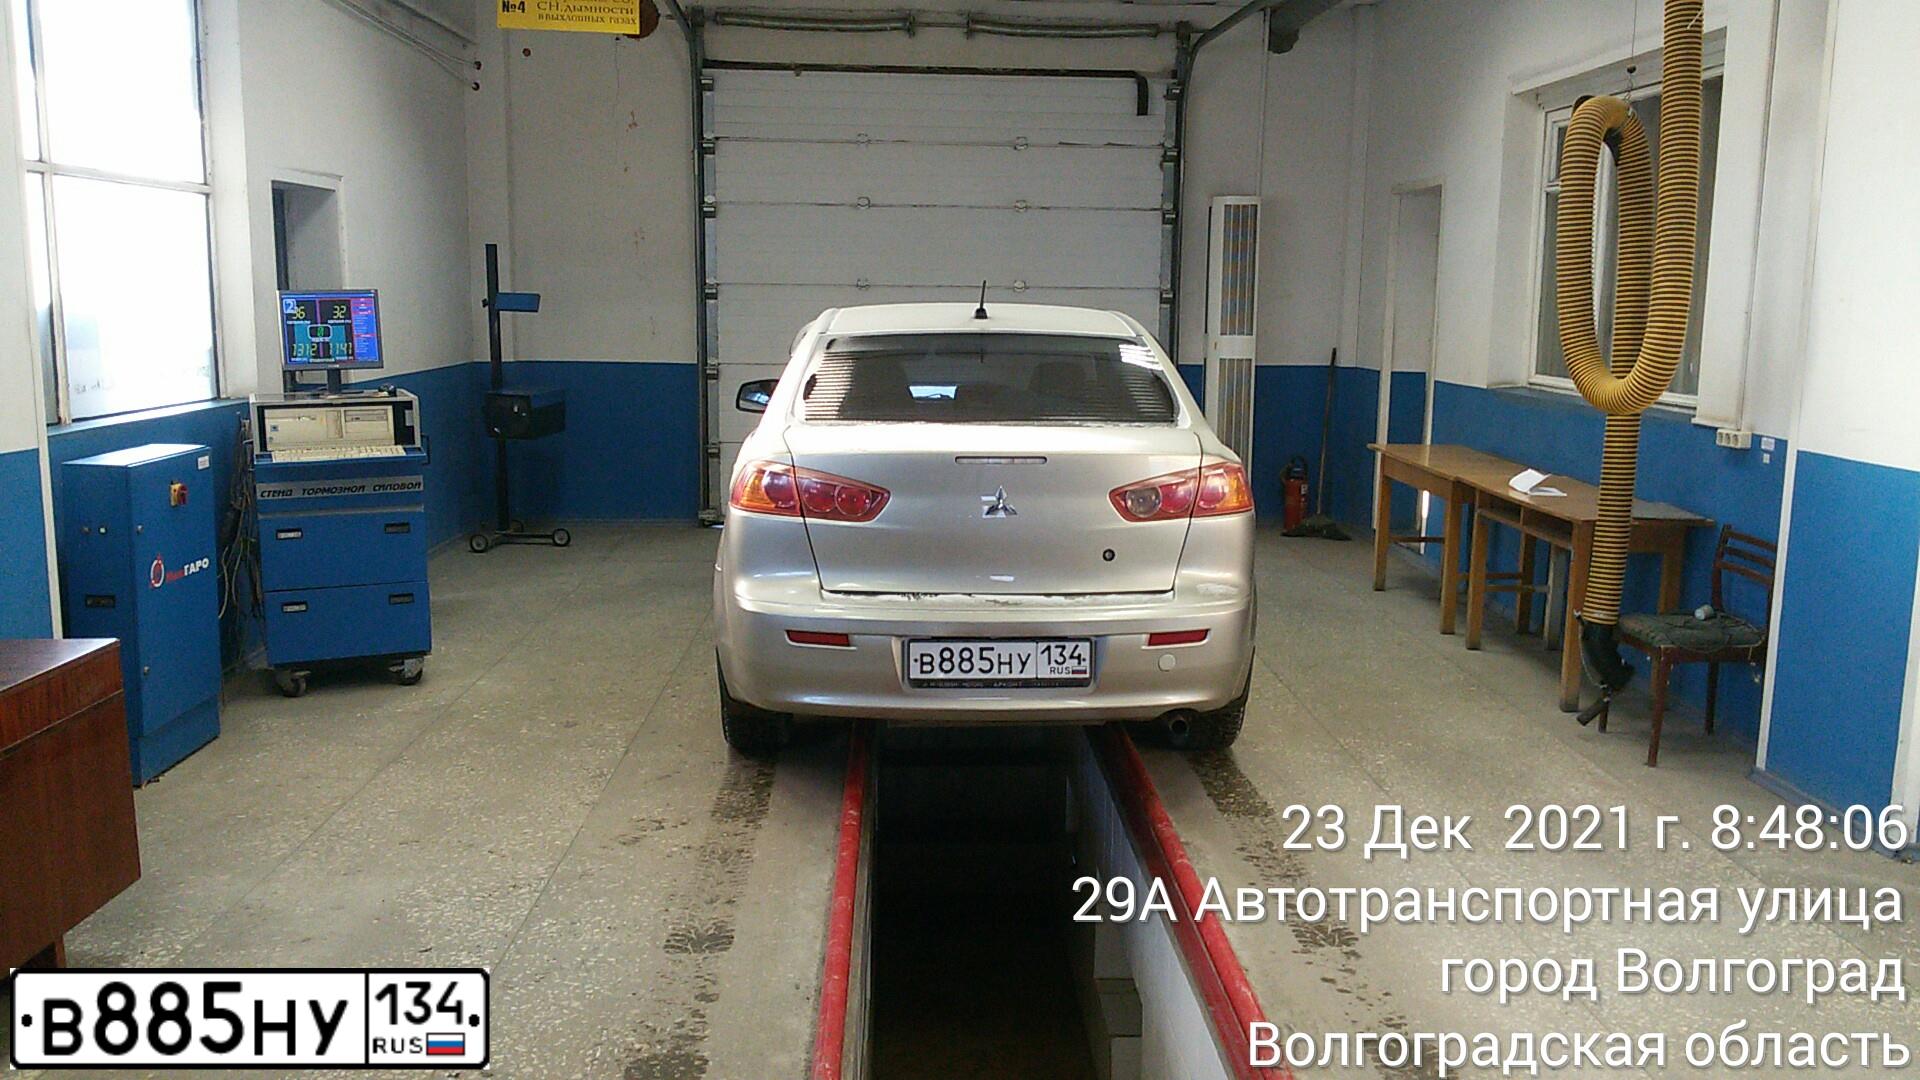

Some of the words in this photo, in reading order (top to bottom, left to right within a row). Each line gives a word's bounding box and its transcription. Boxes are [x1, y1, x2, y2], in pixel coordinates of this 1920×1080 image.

[502, 0, 526, 13] №4
[333, 306, 346, 318] 32
[260, 489, 293, 498] СТЕНД
[919, 646, 1031, 675] В885НУ
[1040, 644, 1082, 666] 134
[1050, 666, 1071, 675] RUS
